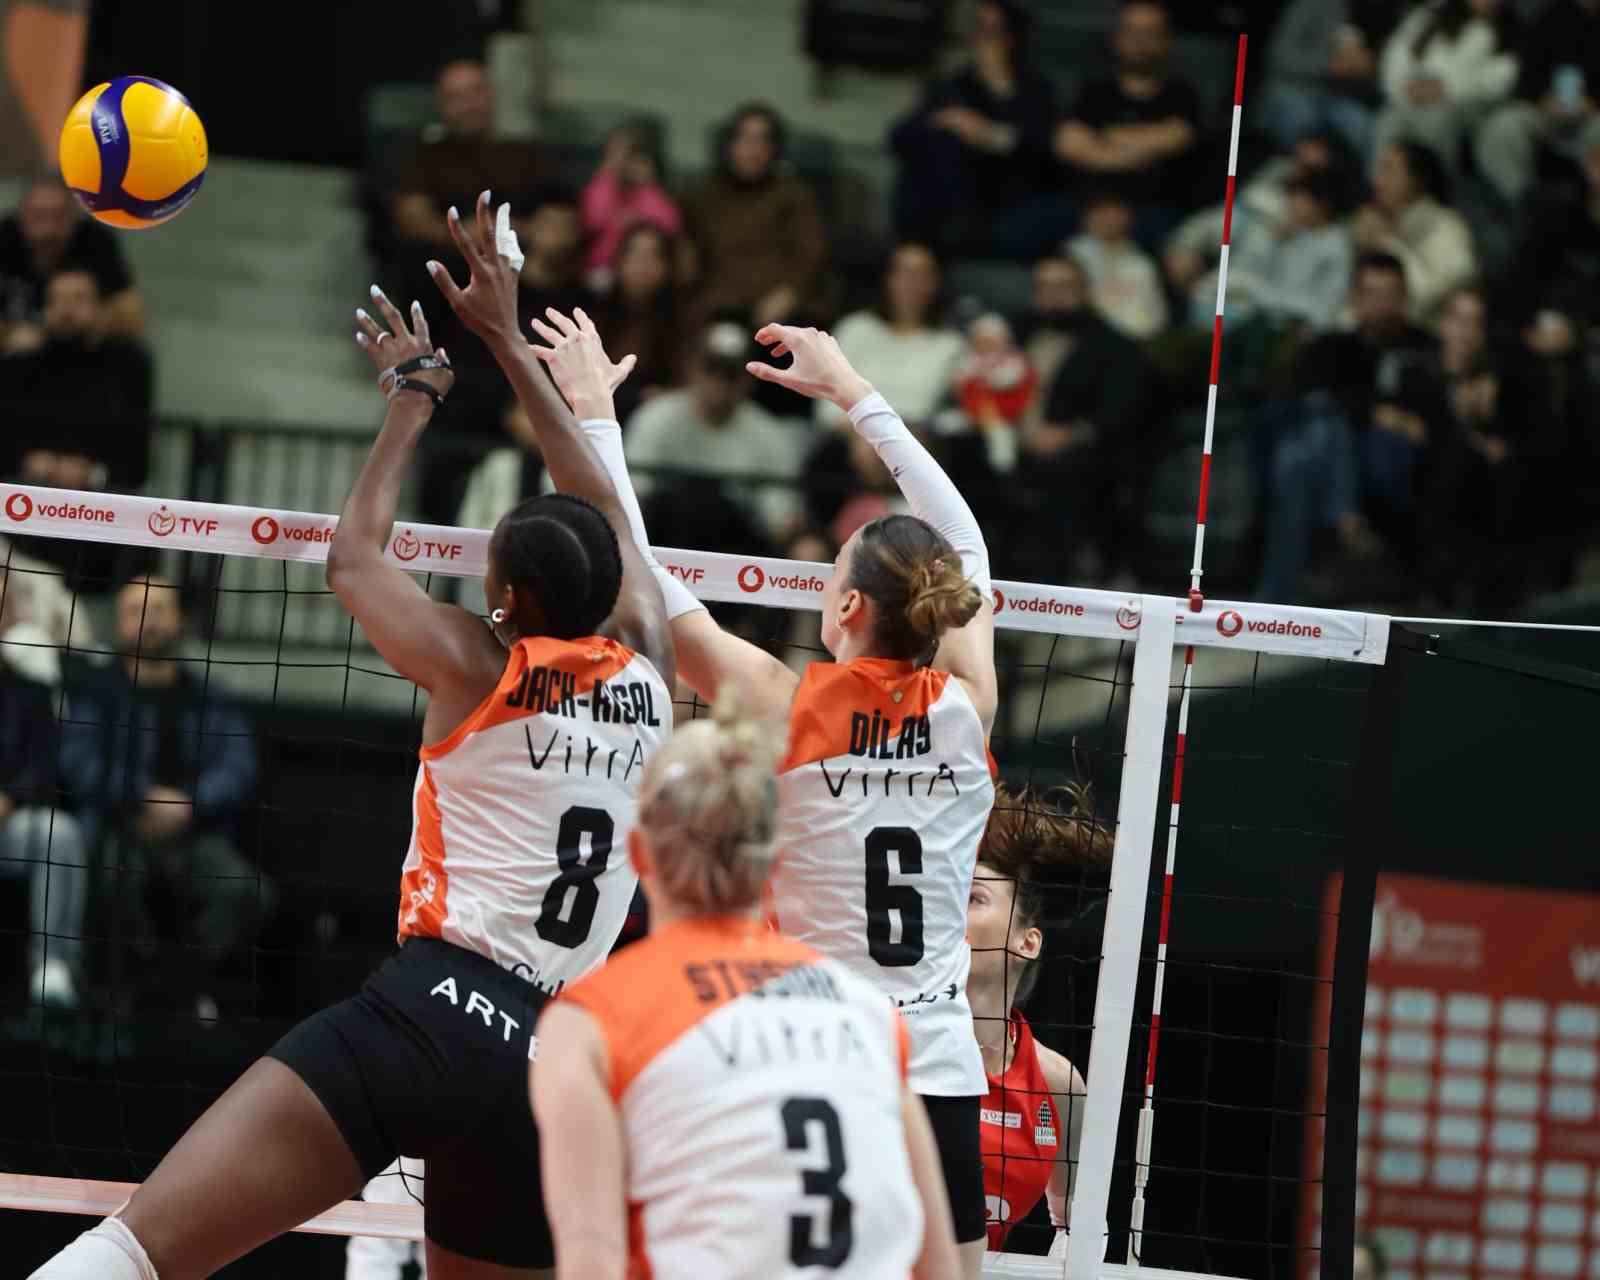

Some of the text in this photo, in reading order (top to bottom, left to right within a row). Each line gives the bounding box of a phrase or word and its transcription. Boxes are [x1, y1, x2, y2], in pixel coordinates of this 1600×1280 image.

[37, 503, 116, 523] vodafone
[179, 517, 218, 535] TVF
[283, 526, 336, 543] vodaf
[424, 542, 463, 561] TVF
[769, 575, 825, 593] vodafo
[1008, 597, 1085, 617] vodafone
[1247, 620, 1322, 638] vodafone
[534, 805, 615, 949] 8
[865, 826, 925, 967] 6
[781, 1097, 856, 1271] 3
